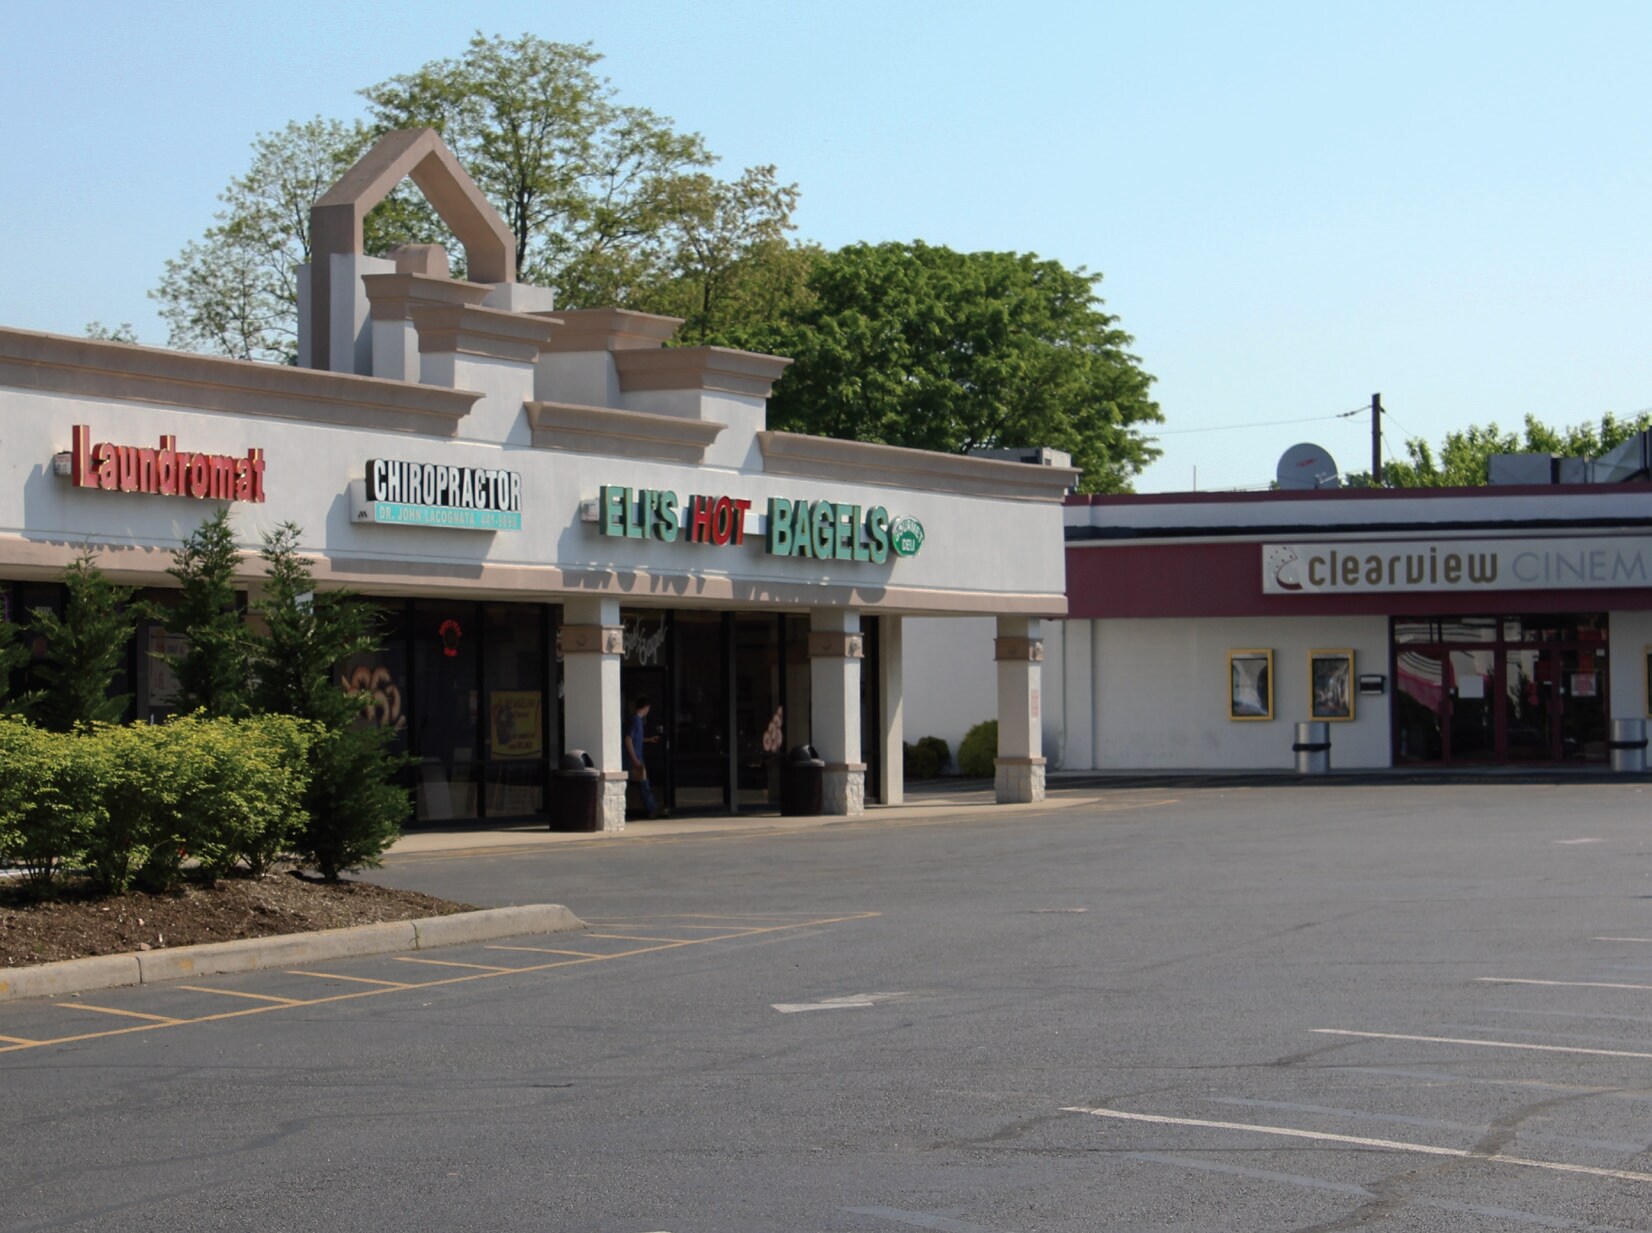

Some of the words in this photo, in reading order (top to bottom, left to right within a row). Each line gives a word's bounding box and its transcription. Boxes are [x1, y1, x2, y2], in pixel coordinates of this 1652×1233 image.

[72, 424, 266, 503] Laundromat
[373, 458, 522, 511] CHIROPRACTOR
[379, 506, 395, 520] DR.
[398, 507, 421, 521] JOHN
[600, 484, 679, 543] ELI'S
[686, 494, 751, 546] HOT
[766, 497, 889, 565] BAGELS
[1307, 547, 1498, 586] clearview
